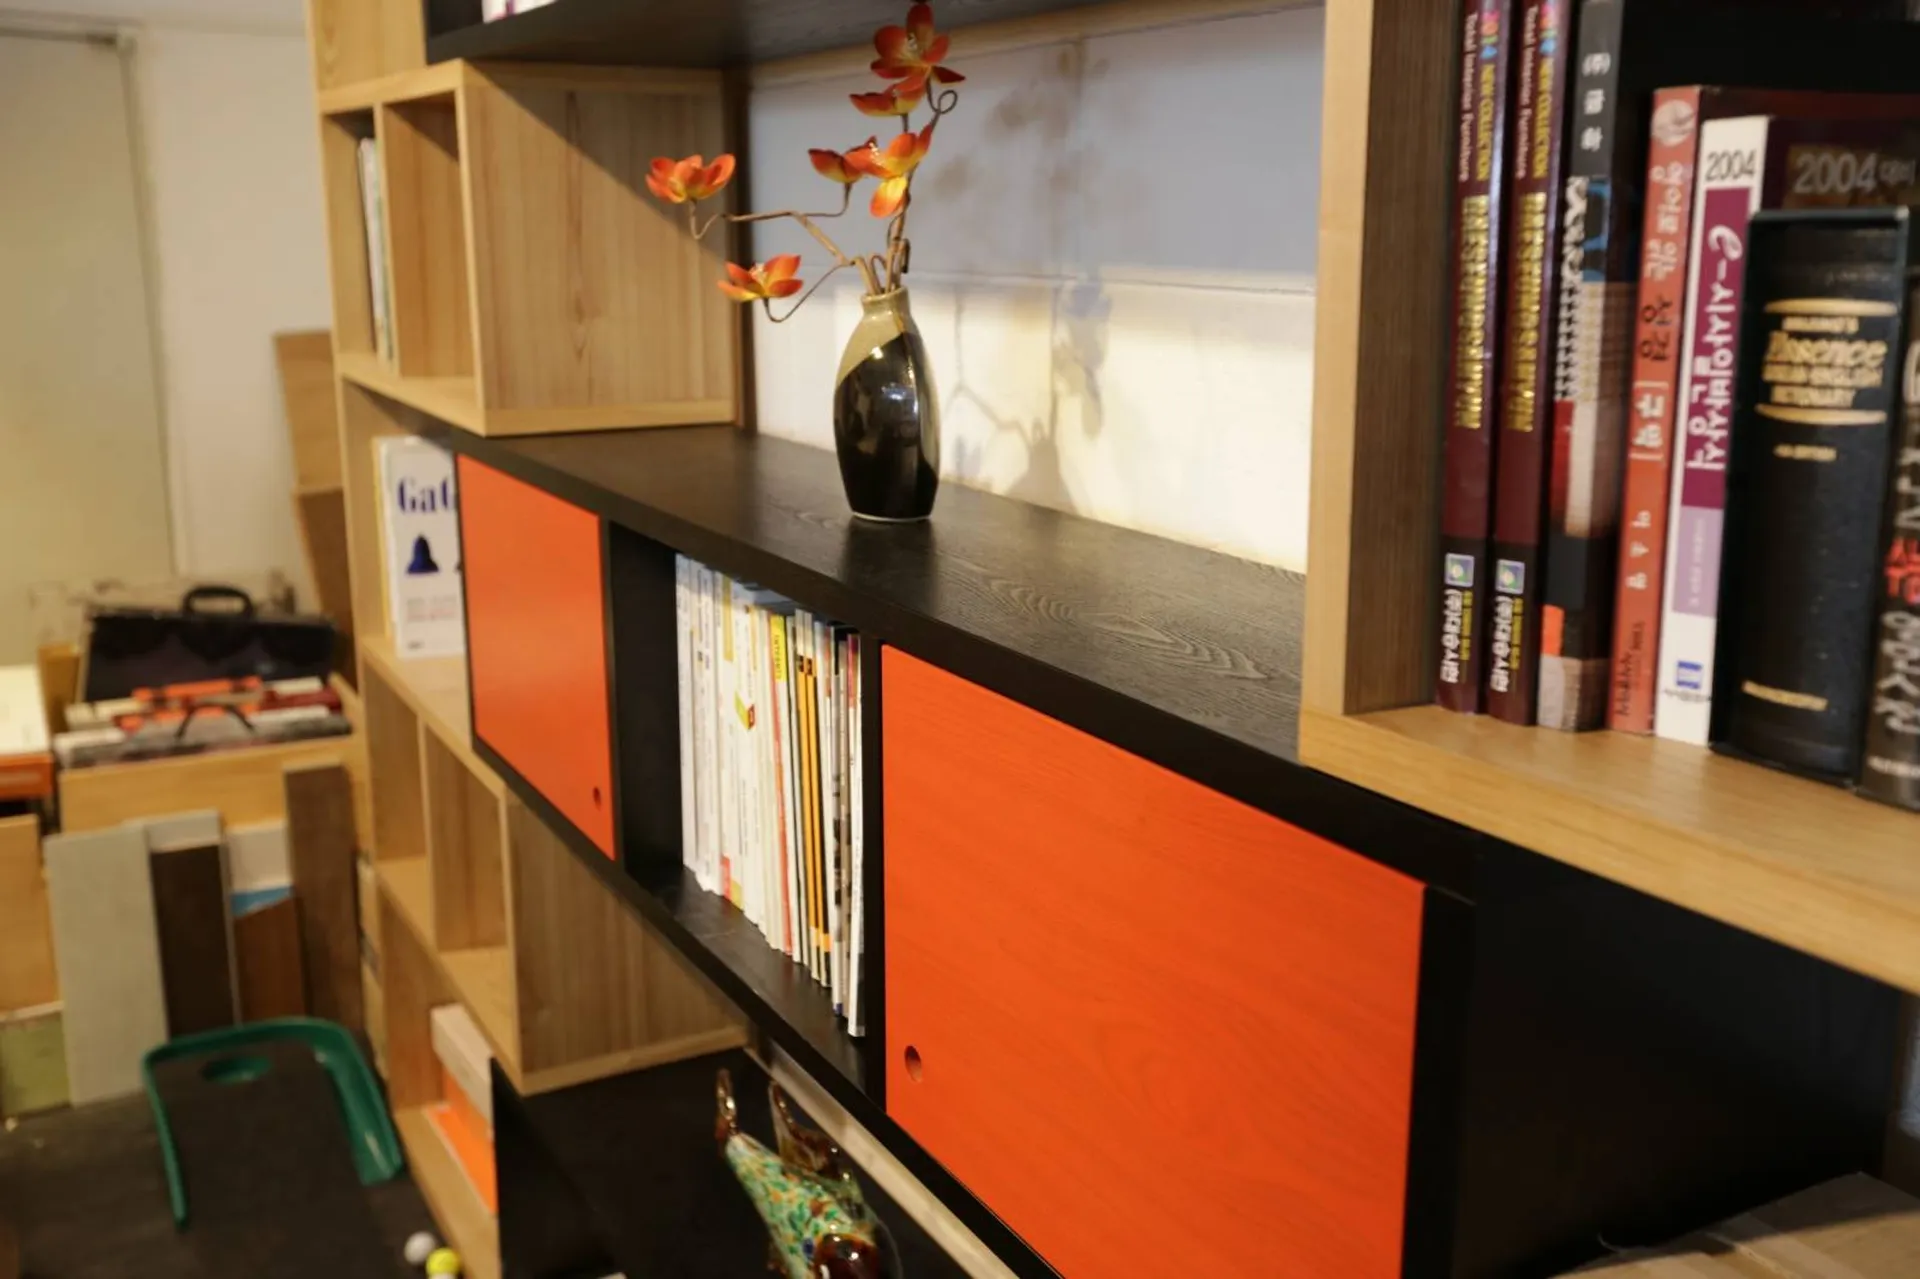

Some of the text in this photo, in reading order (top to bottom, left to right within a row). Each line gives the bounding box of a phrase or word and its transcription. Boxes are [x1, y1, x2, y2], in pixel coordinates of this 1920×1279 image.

[1461, 53, 1476, 110] Interior
[1458, 112, 1474, 183] Furniture
[1705, 149, 1757, 182] 2004
[1640, 292, 1674, 363] 성경
